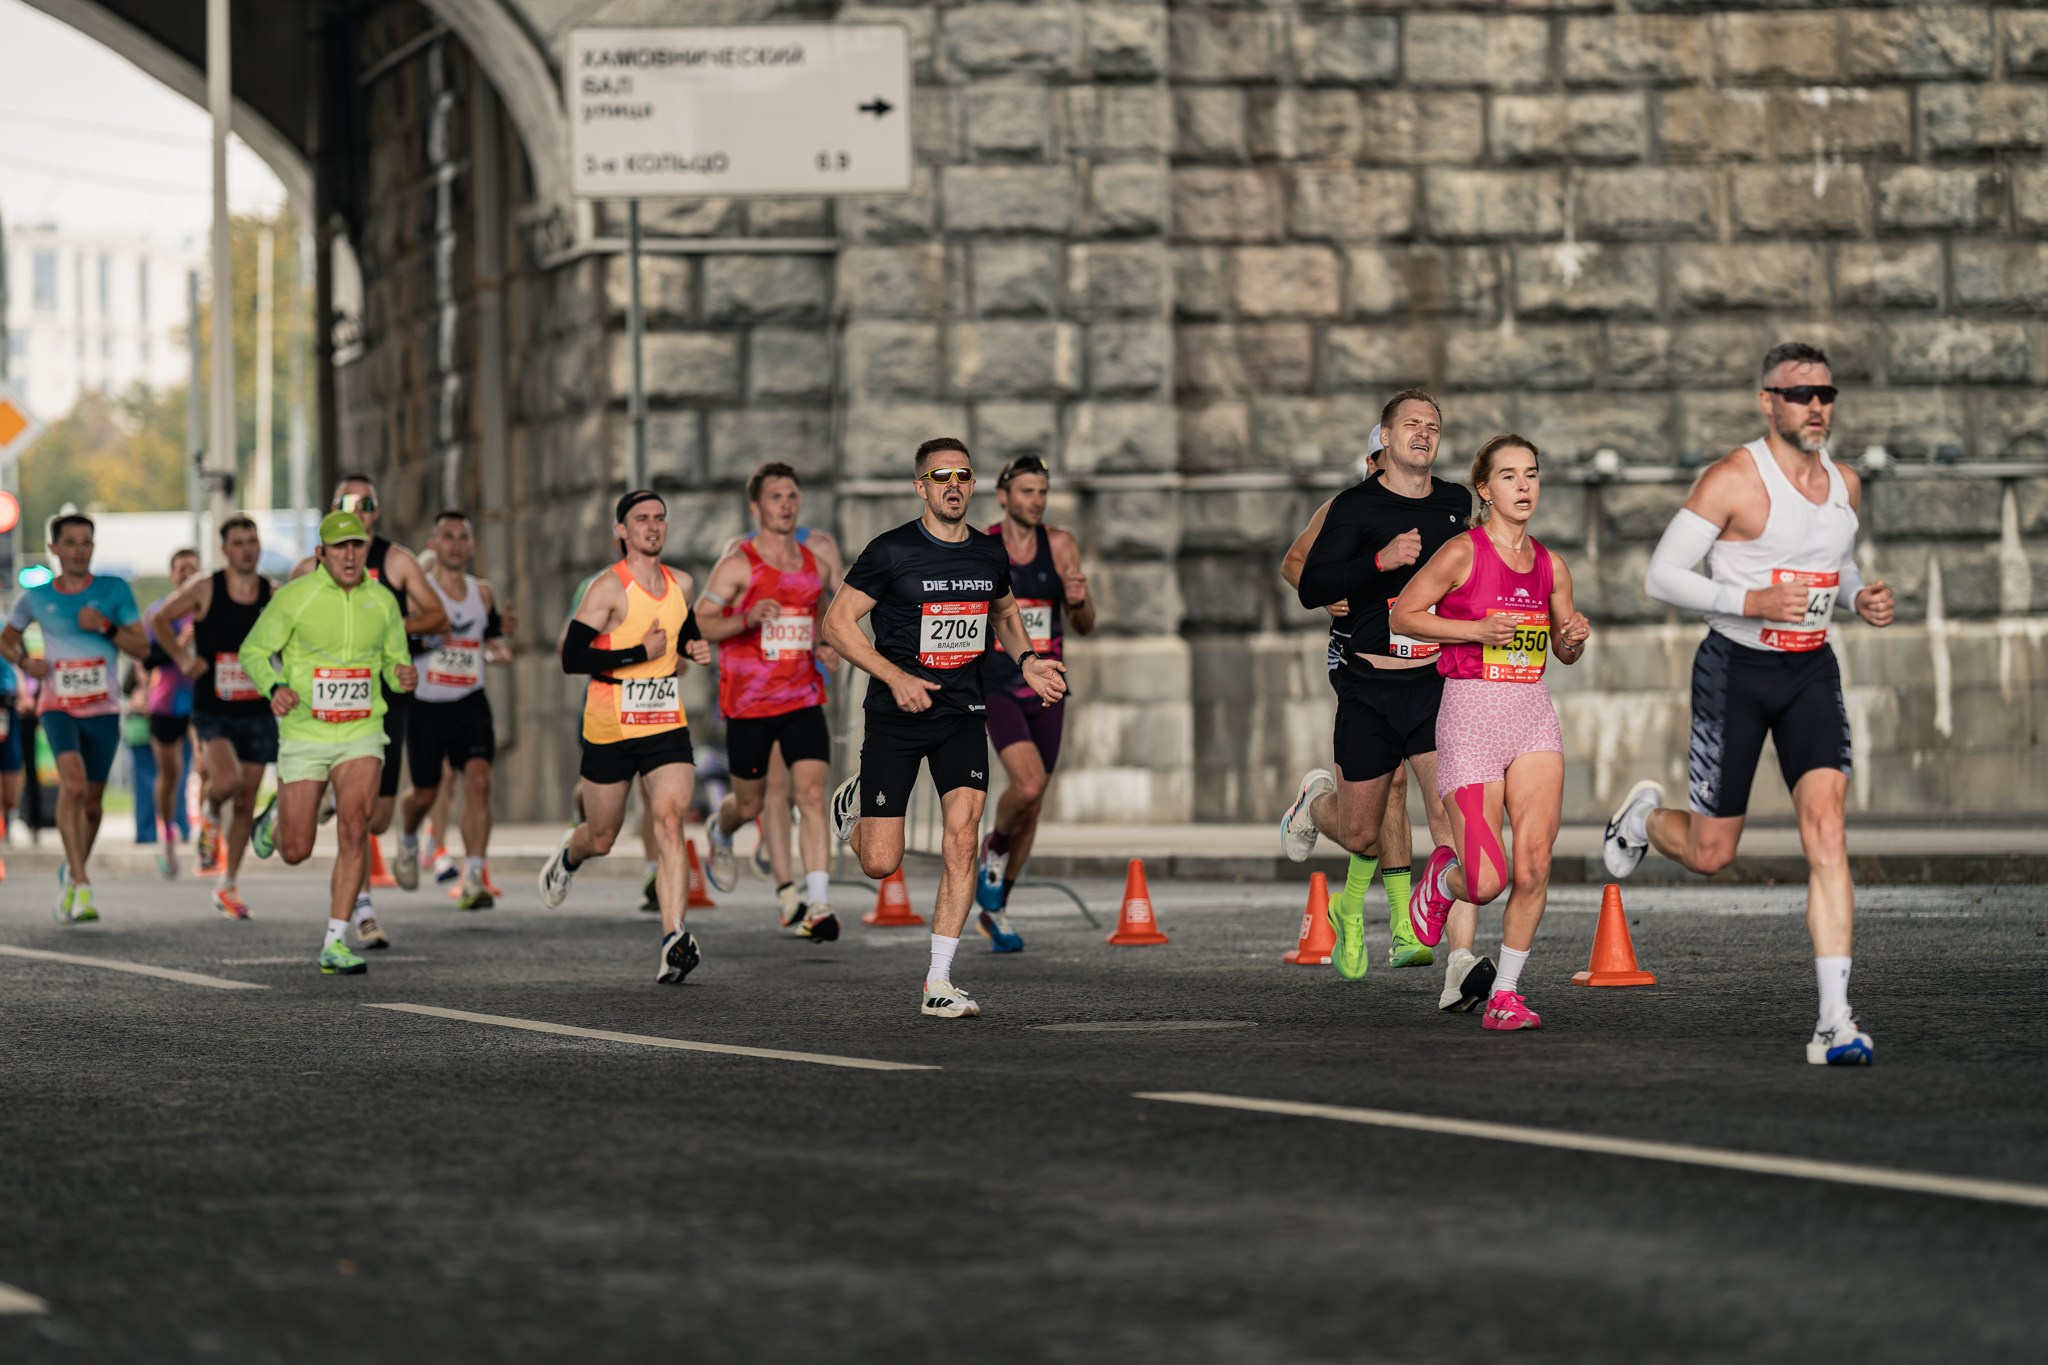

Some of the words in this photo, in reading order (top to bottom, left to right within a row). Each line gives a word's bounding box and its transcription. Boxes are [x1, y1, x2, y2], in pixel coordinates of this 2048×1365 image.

[581, 44, 806, 67] ХАМОВНИЧЕСКИЙ
[582, 77, 633, 95] ВАЛ
[581, 103, 653, 124] улица
[625, 154, 730, 175] КОЛЬЦО
[922, 580, 949, 592] DIE
[950, 579, 994, 591] HARD
[1807, 593, 1831, 616] 43
[931, 619, 978, 640] 2706
[1021, 612, 1043, 628] 84
[937, 641, 971, 649] ВЛАДИЛЕН
[1492, 630, 1548, 651] 550
[317, 681, 369, 699] 19723
[626, 682, 676, 700] 17764
